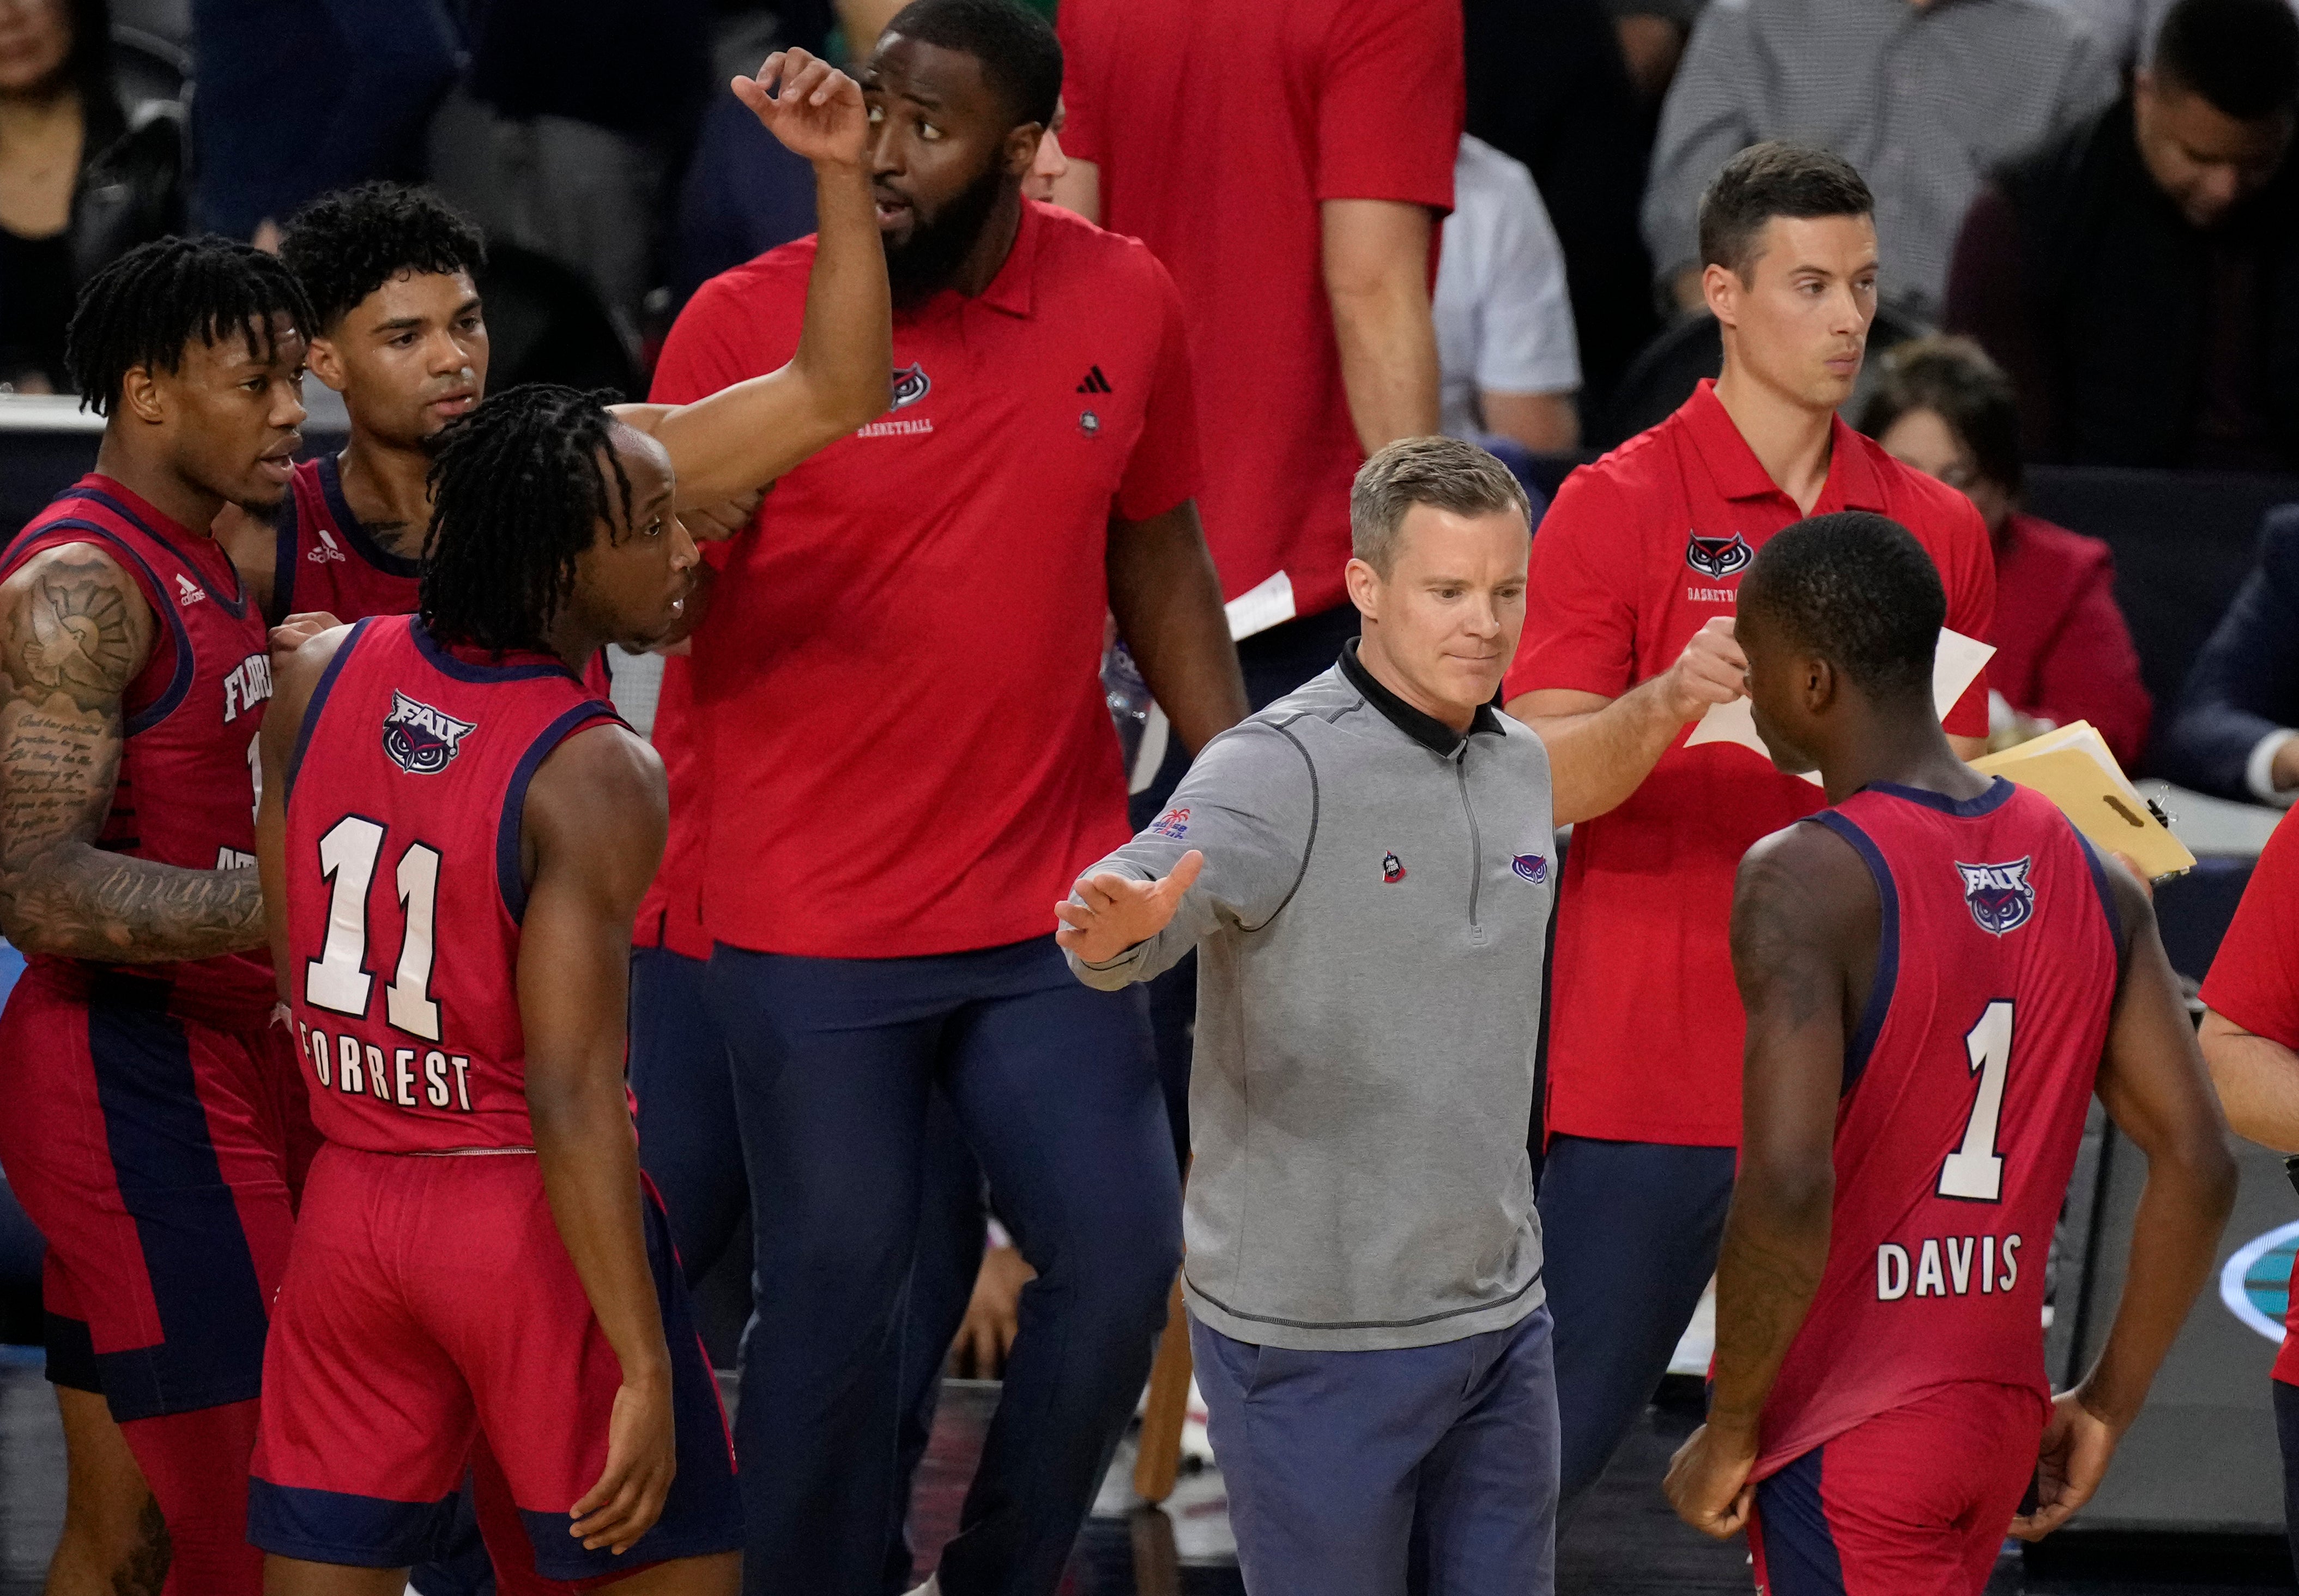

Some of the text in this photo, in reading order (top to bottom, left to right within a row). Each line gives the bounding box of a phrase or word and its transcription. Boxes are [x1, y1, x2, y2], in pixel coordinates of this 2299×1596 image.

[857, 418, 933, 438] BASKETBALL
[1687, 587, 1738, 602] BASKETB
[388, 692, 469, 748] FAU
[1961, 863, 2026, 897] FAU
[304, 814, 440, 1044] 11
[1937, 1000, 2016, 1201] 1
[1877, 1233, 2023, 1301] DAVIS
